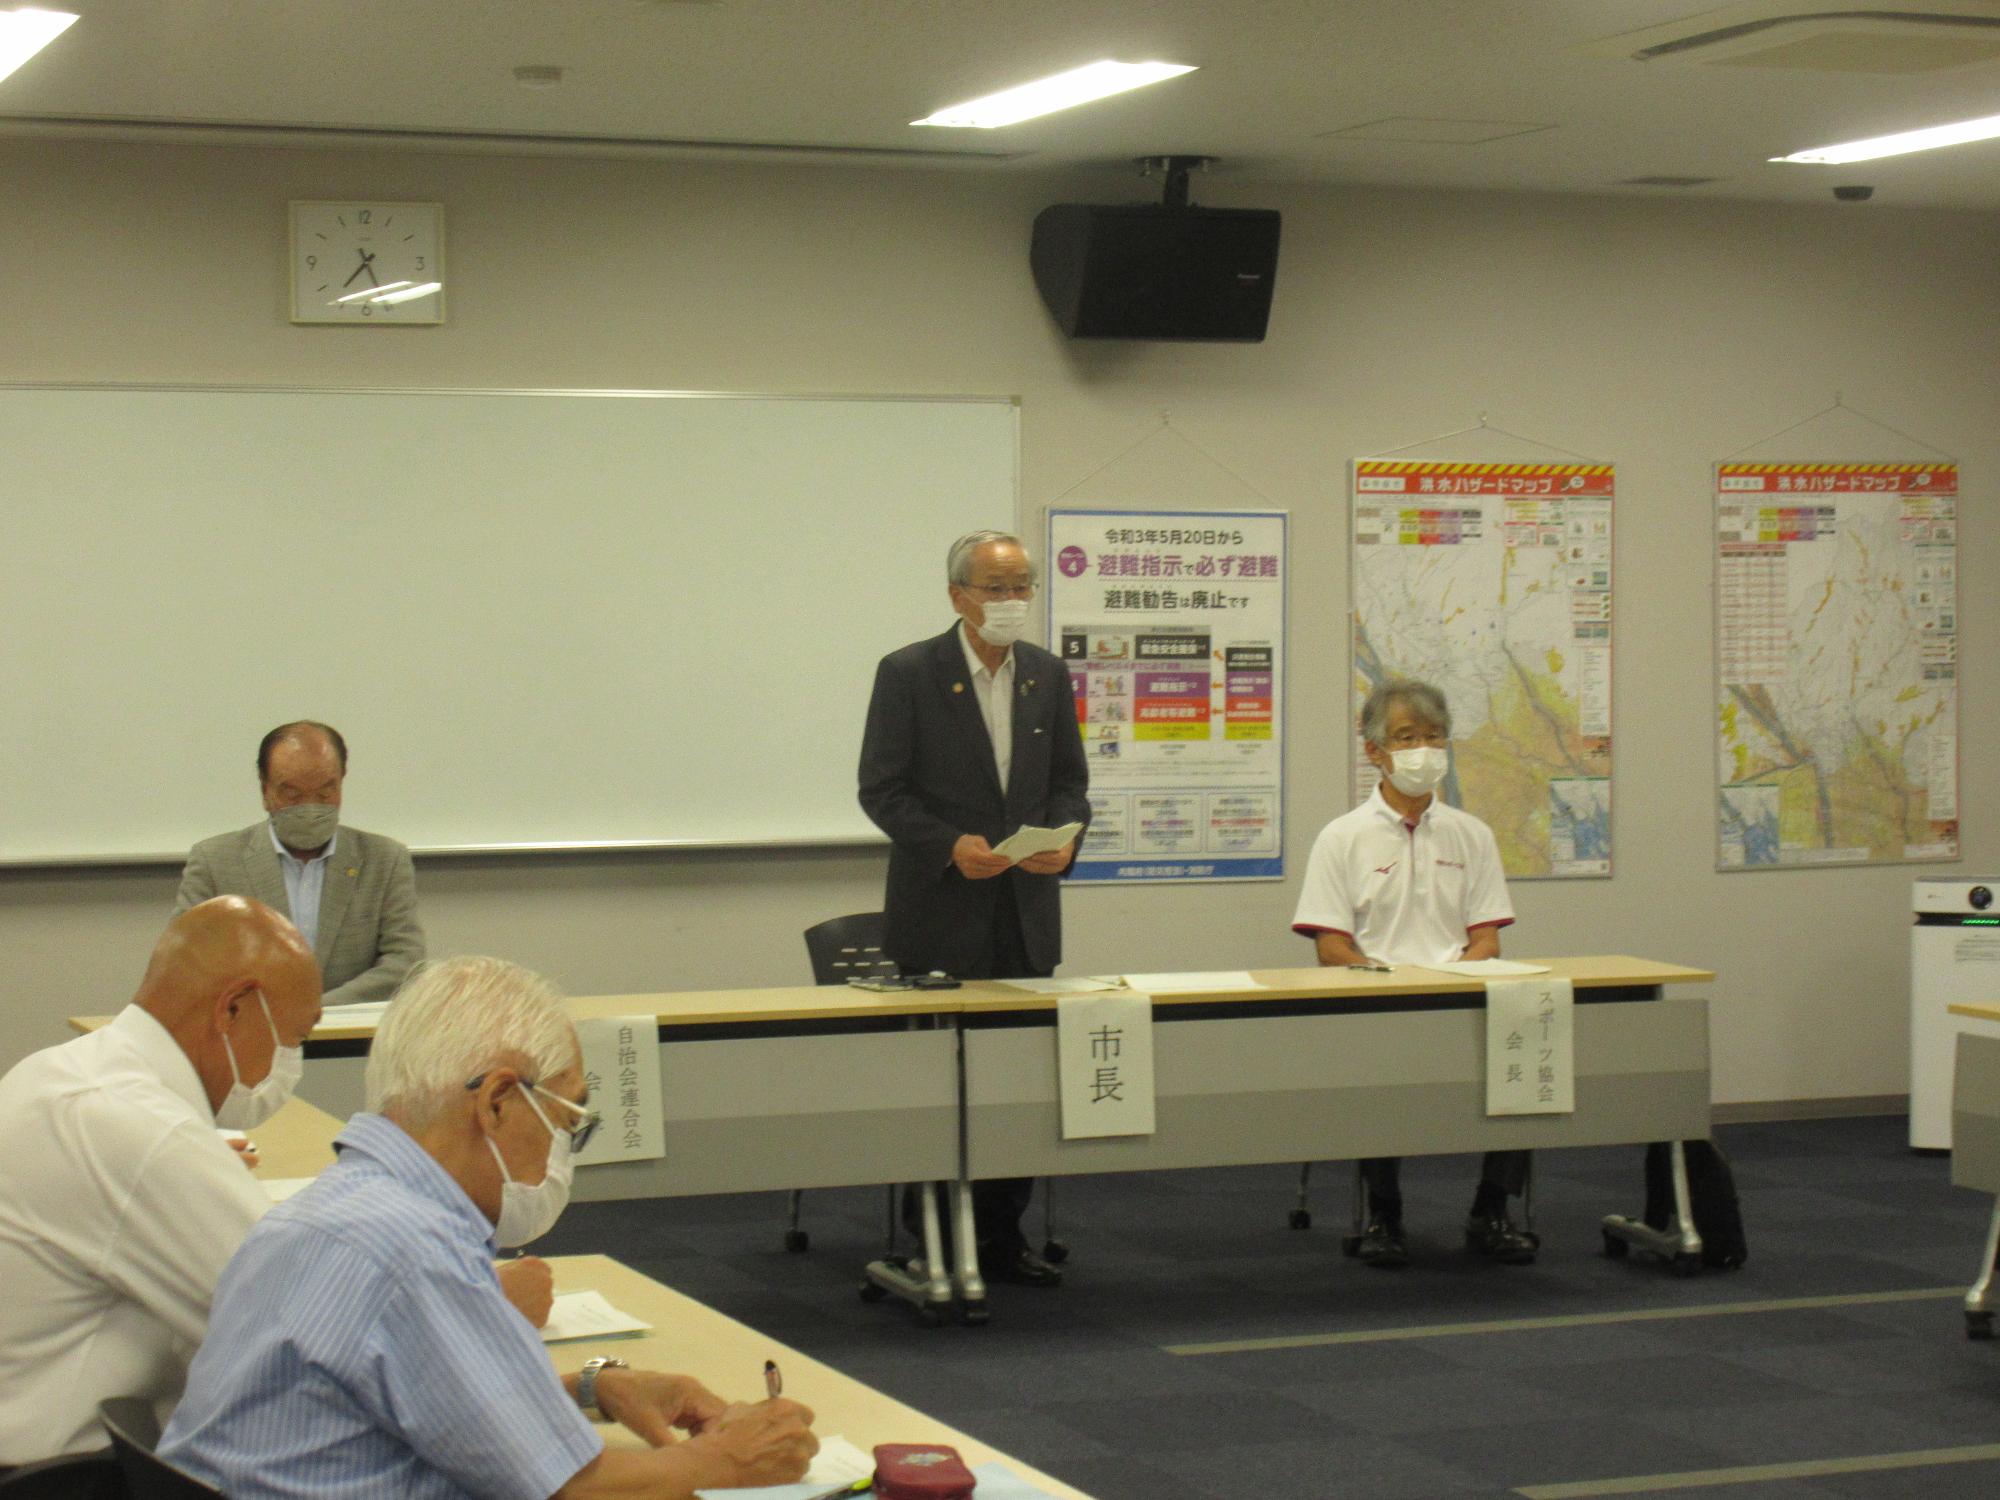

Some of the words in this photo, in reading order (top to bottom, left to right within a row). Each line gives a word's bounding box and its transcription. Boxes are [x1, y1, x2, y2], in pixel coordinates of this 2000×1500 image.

[359, 210, 372, 224] 12
[306, 255, 317, 271] 9
[415, 256, 425, 271] 3
[1105, 529, 1244, 545] 令和3年5月20日から
[1097, 554, 1279, 577] 避難指示で必ず避難
[1104, 590, 1249, 609] 避難勧告は廃止です
[1069, 641, 1080, 654] 5
[1088, 1024, 1124, 1104] 市長
[1506, 1031, 1524, 1083] 会長
[618, 1025, 642, 1149] 自治会連合会
